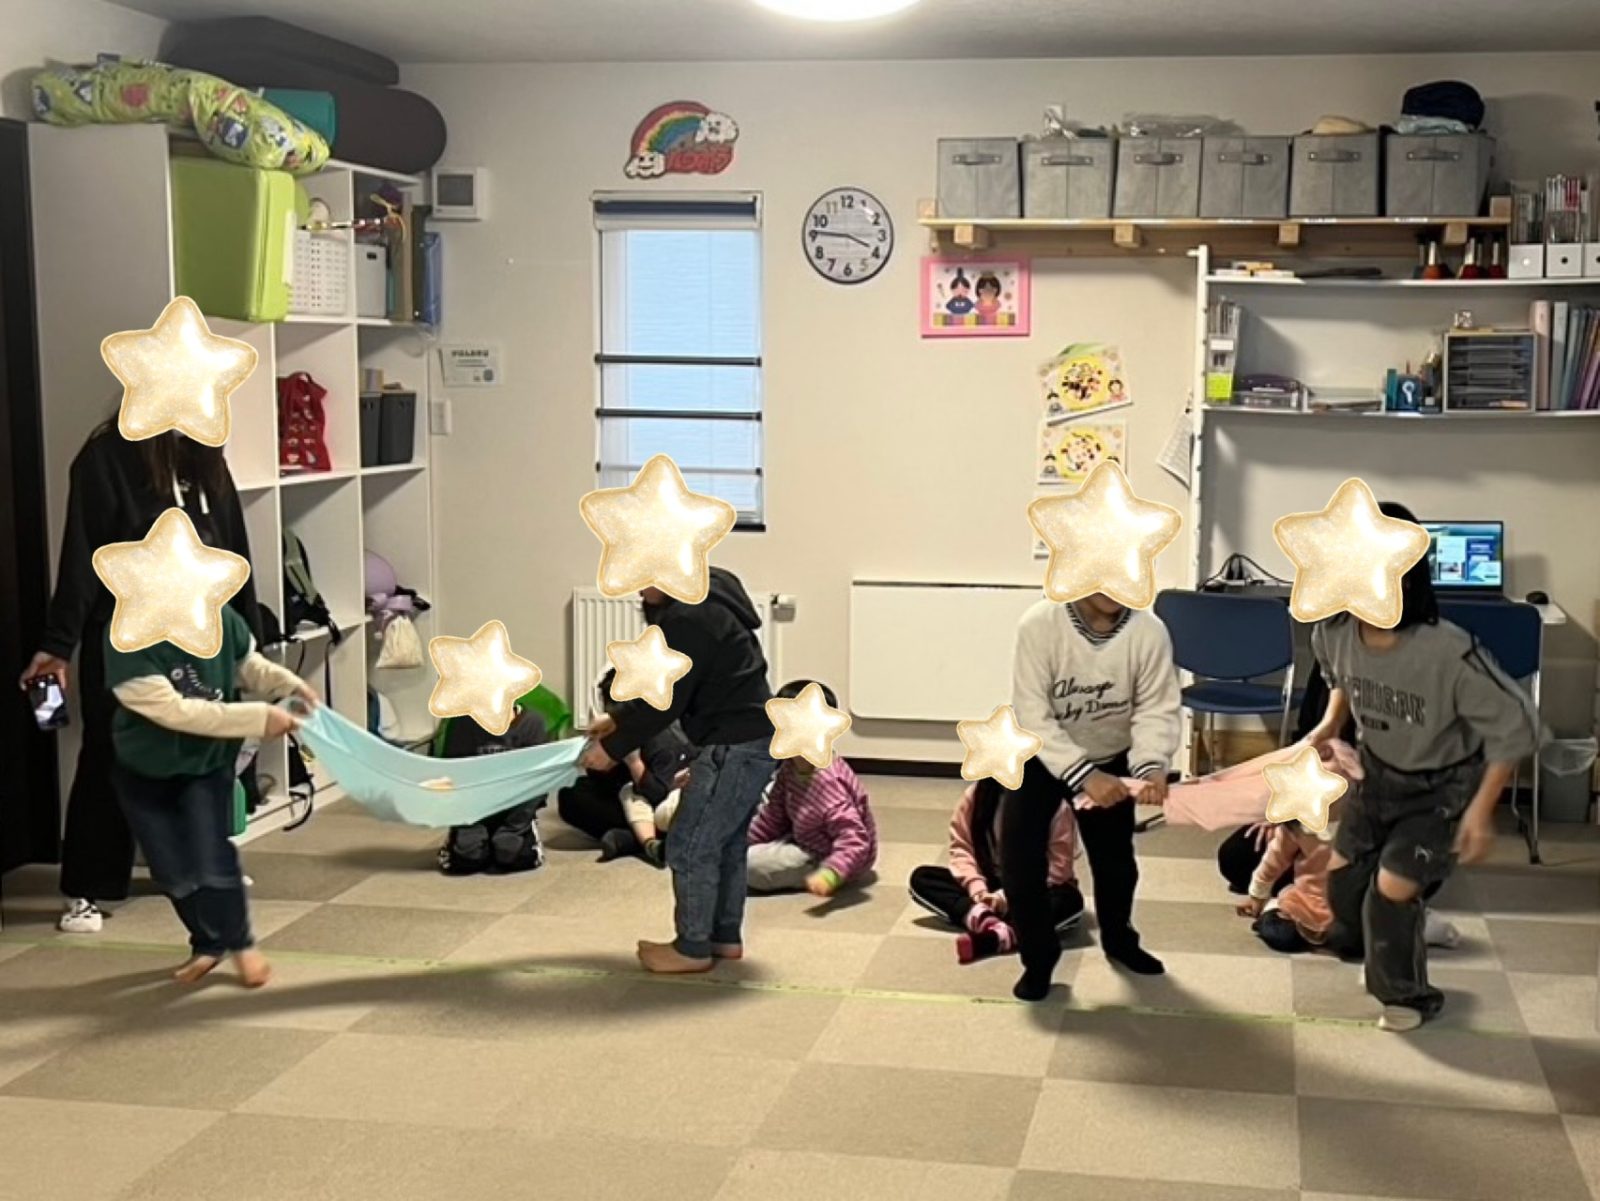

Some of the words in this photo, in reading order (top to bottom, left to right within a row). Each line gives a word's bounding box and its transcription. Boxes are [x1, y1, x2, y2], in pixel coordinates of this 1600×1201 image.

[826, 201, 838, 214] 11
[841, 195, 854, 209] 12
[813, 214, 828, 228] 10
[872, 212, 881, 226] 2
[809, 229, 818, 242] 9
[878, 229, 886, 242] 3
[815, 245, 824, 260] 8
[871, 246, 880, 259] 4
[827, 258, 837, 272] 7
[843, 262, 853, 277] 6
[860, 258, 869, 272] 5
